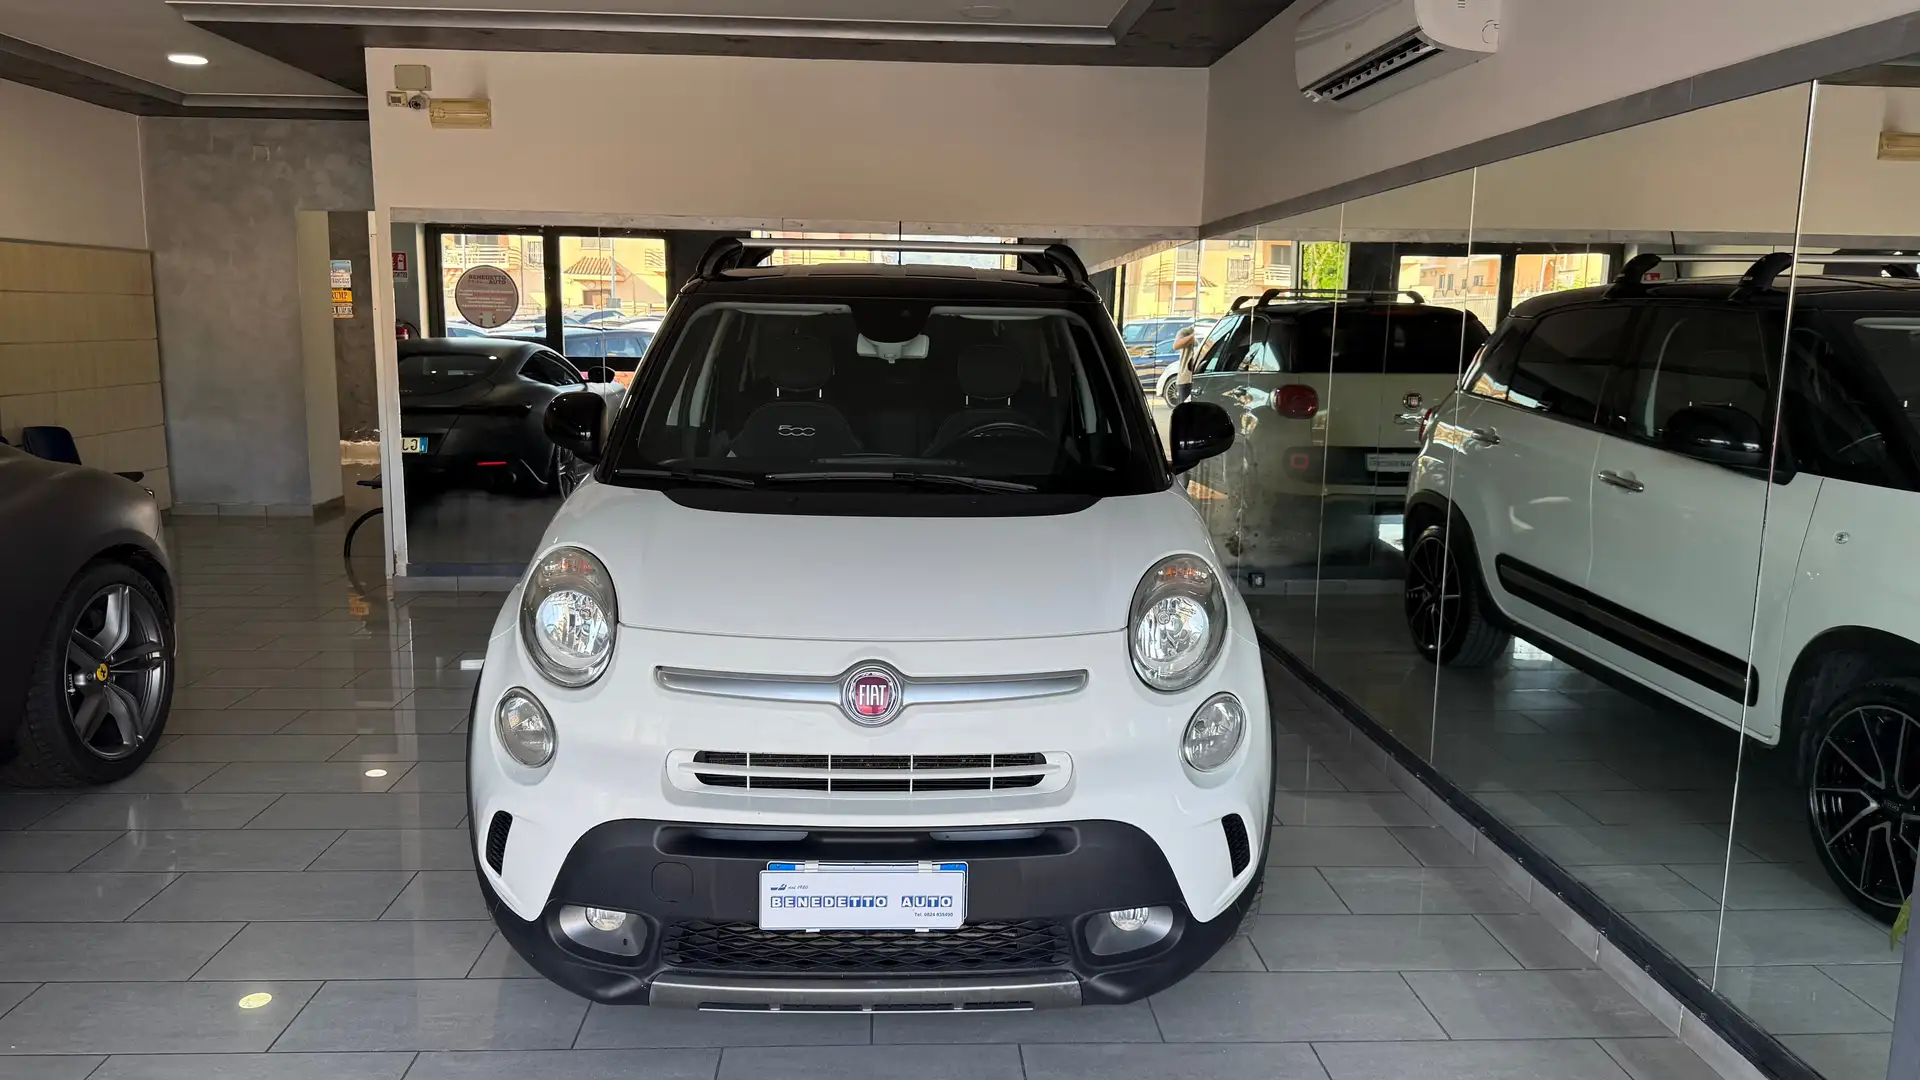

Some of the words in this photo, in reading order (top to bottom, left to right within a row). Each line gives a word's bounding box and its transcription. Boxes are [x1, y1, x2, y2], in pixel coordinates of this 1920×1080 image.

[778, 425, 816, 436] 500
[859, 684, 887, 706] FIAT
[770, 895, 887, 908] BENEDETTO
[901, 895, 953, 908] AUTO
